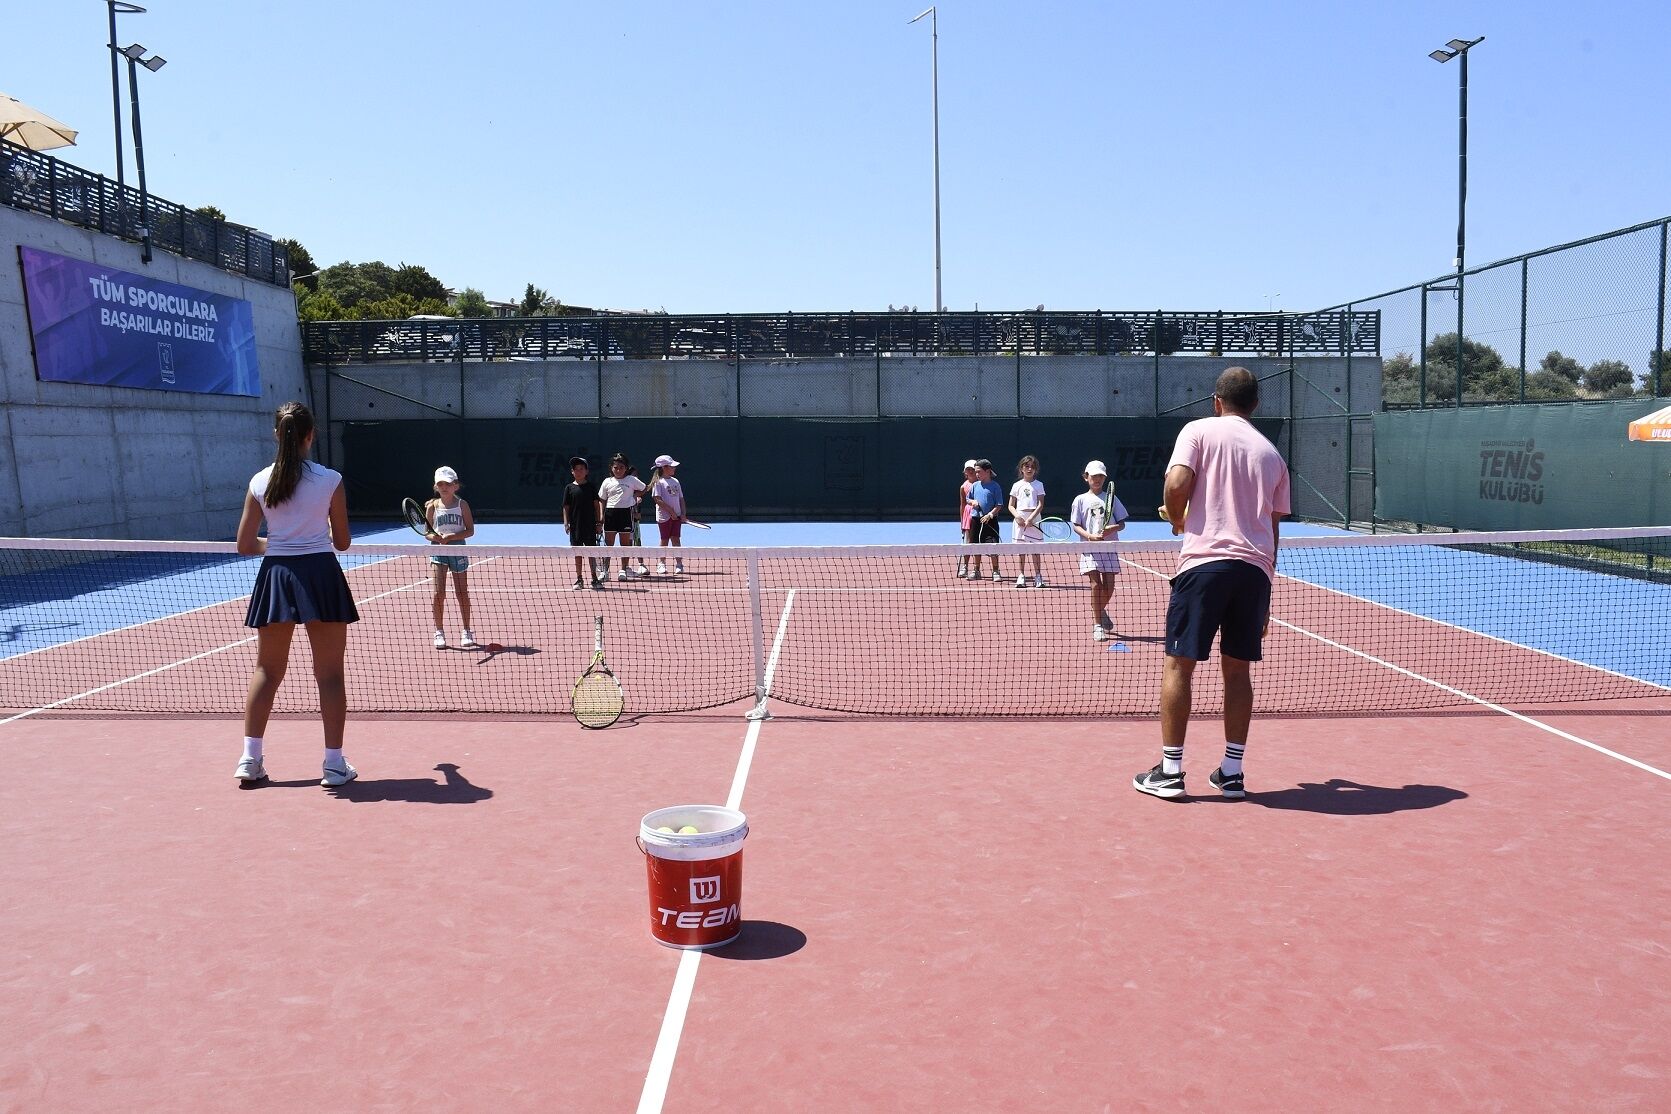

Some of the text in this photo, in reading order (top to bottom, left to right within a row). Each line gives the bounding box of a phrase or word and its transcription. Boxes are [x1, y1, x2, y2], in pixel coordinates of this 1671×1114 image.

[89, 275, 219, 322] TÜM SPORCULARA
[100, 308, 215, 343] BAŞARILAR DİLERİZ
[1480, 480, 1544, 505] KULÜBÜ
